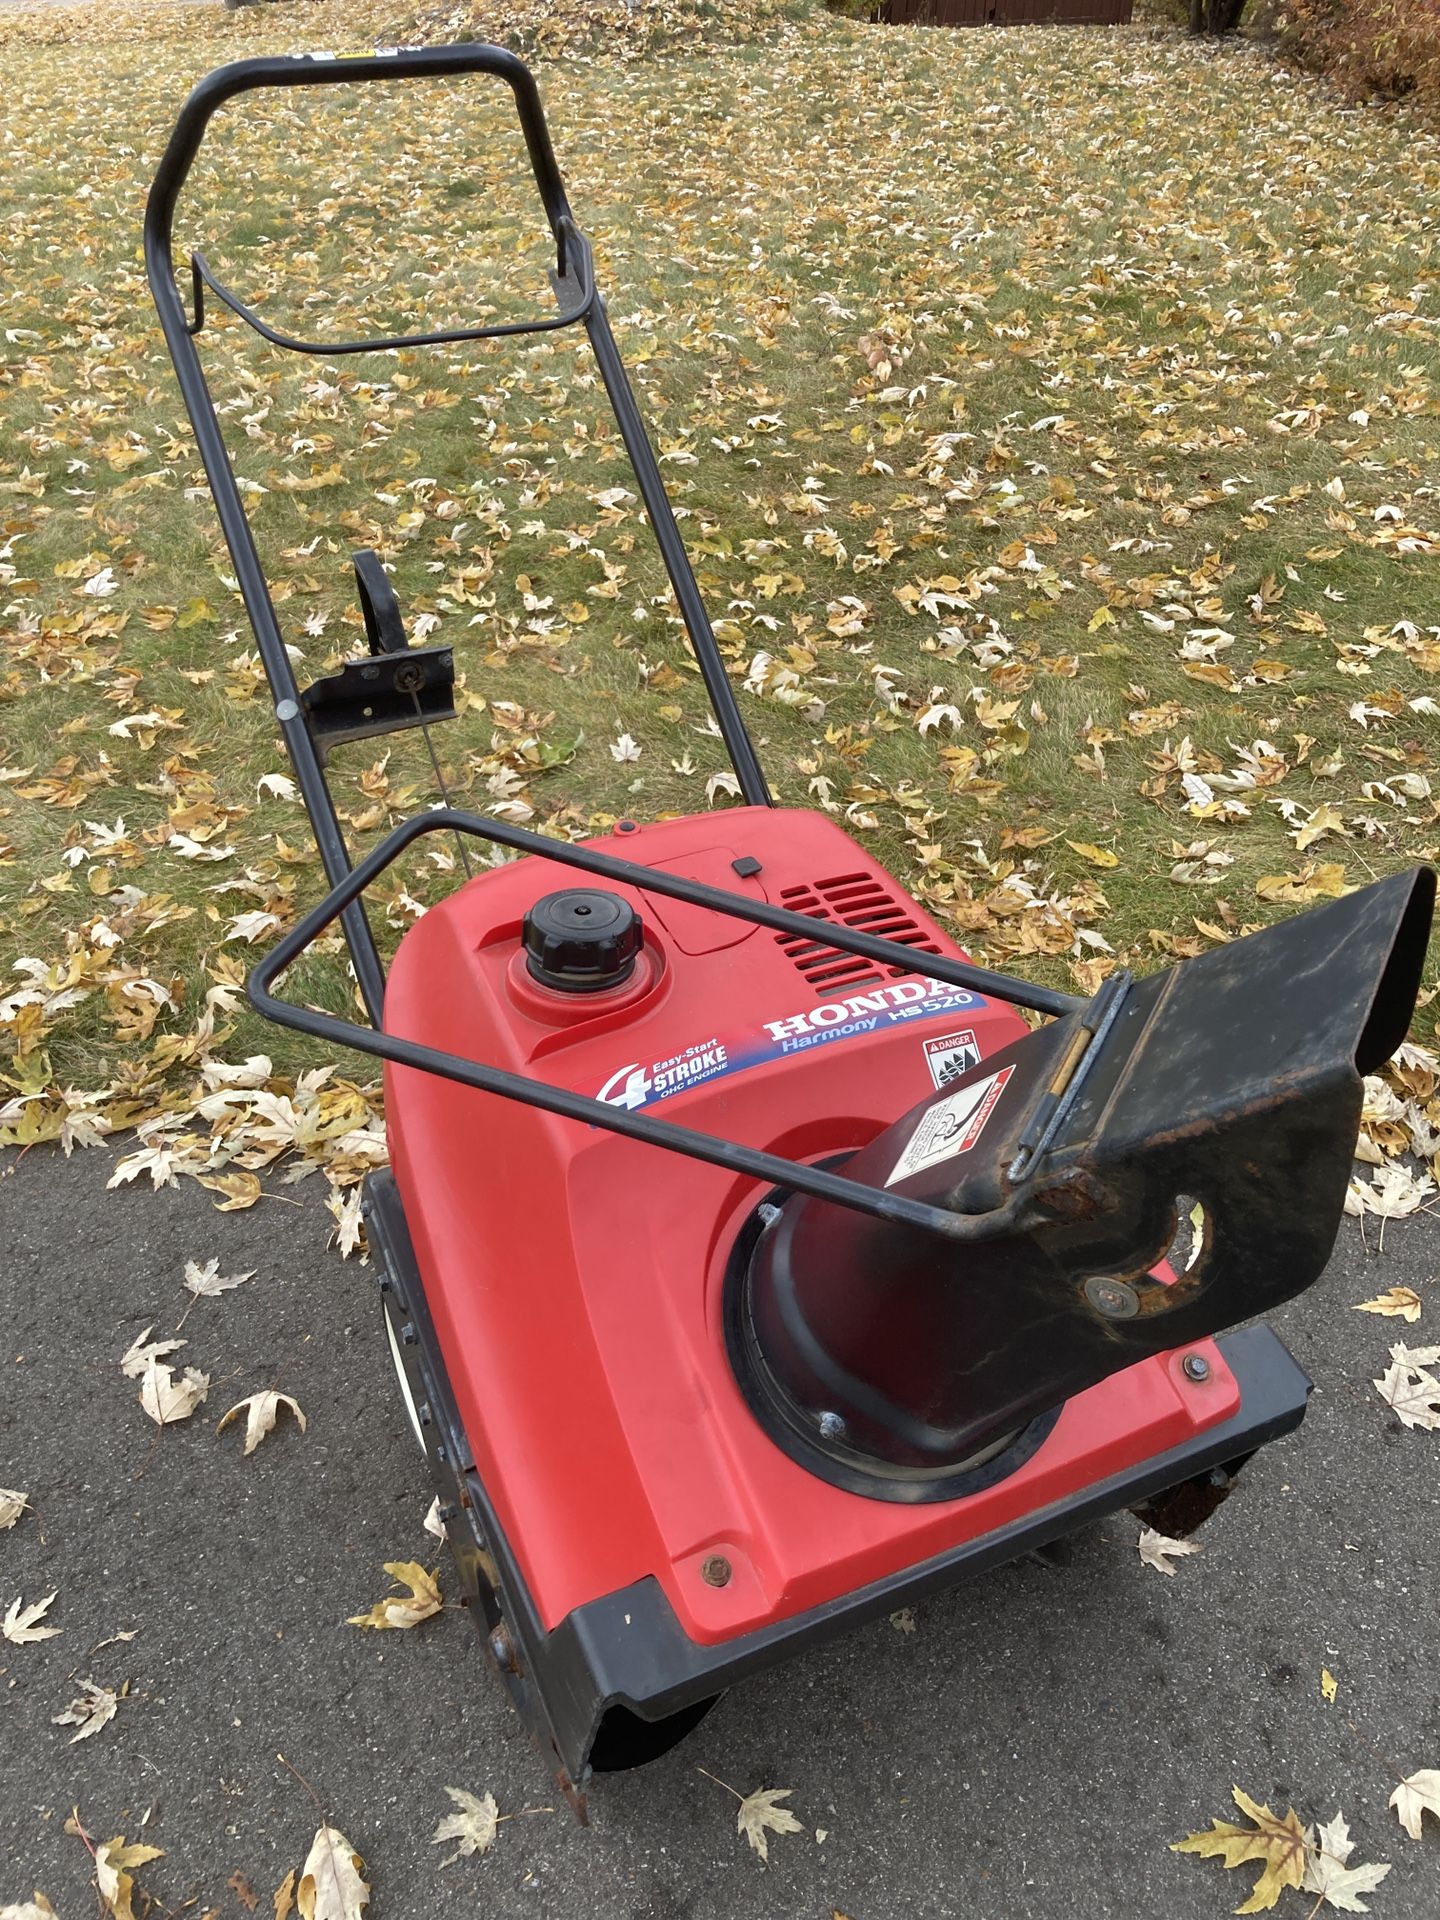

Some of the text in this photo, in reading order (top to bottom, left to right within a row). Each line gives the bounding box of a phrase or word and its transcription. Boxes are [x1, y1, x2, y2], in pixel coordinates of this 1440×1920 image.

[762, 977, 966, 1042] HONDA
[782, 1016, 877, 1052] Harmony
[938, 1035, 971, 1050] DANGER
[652, 1038, 718, 1073] Easy-Start
[595, 1045, 727, 1110] 4 STROKE
[660, 1061, 728, 1098] OHC ENGINE
[965, 1093, 996, 1141] DANGER
